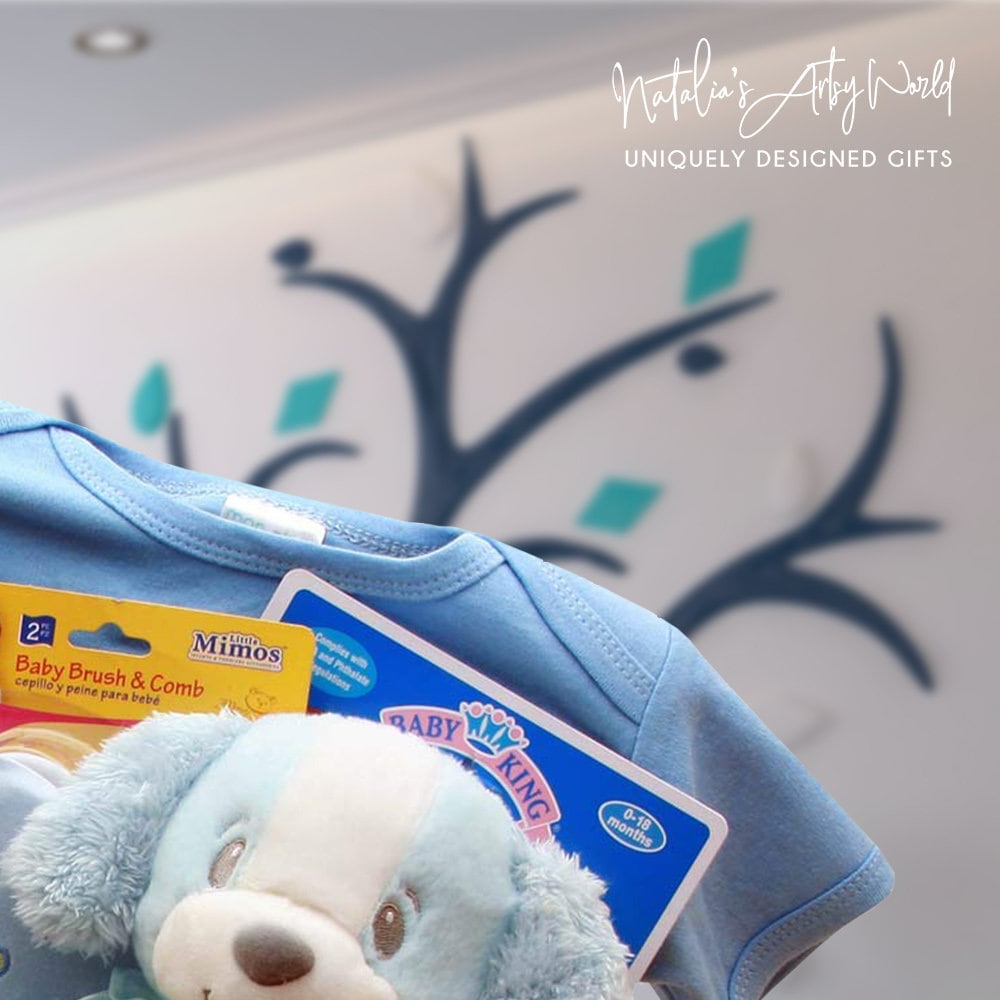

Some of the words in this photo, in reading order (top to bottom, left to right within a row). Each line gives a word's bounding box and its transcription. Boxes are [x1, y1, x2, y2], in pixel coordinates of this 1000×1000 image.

[26, 621, 40, 641] 2
[230, 635, 258, 646] Little
[193, 633, 281, 663] Mimos
[15, 655, 63, 683] Baby
[69, 662, 126, 688] Brush
[131, 670, 146, 691] &
[150, 673, 205, 699] Comb
[15, 677, 53, 691] cepillo
[56, 683, 64, 694] y
[66, 684, 98, 697] peine
[101, 690, 128, 702] para
[388, 713, 462, 742] BABY
[496, 752, 551, 821] KING
[606, 815, 653, 848] months
[623, 808, 652, 831] 0-18
